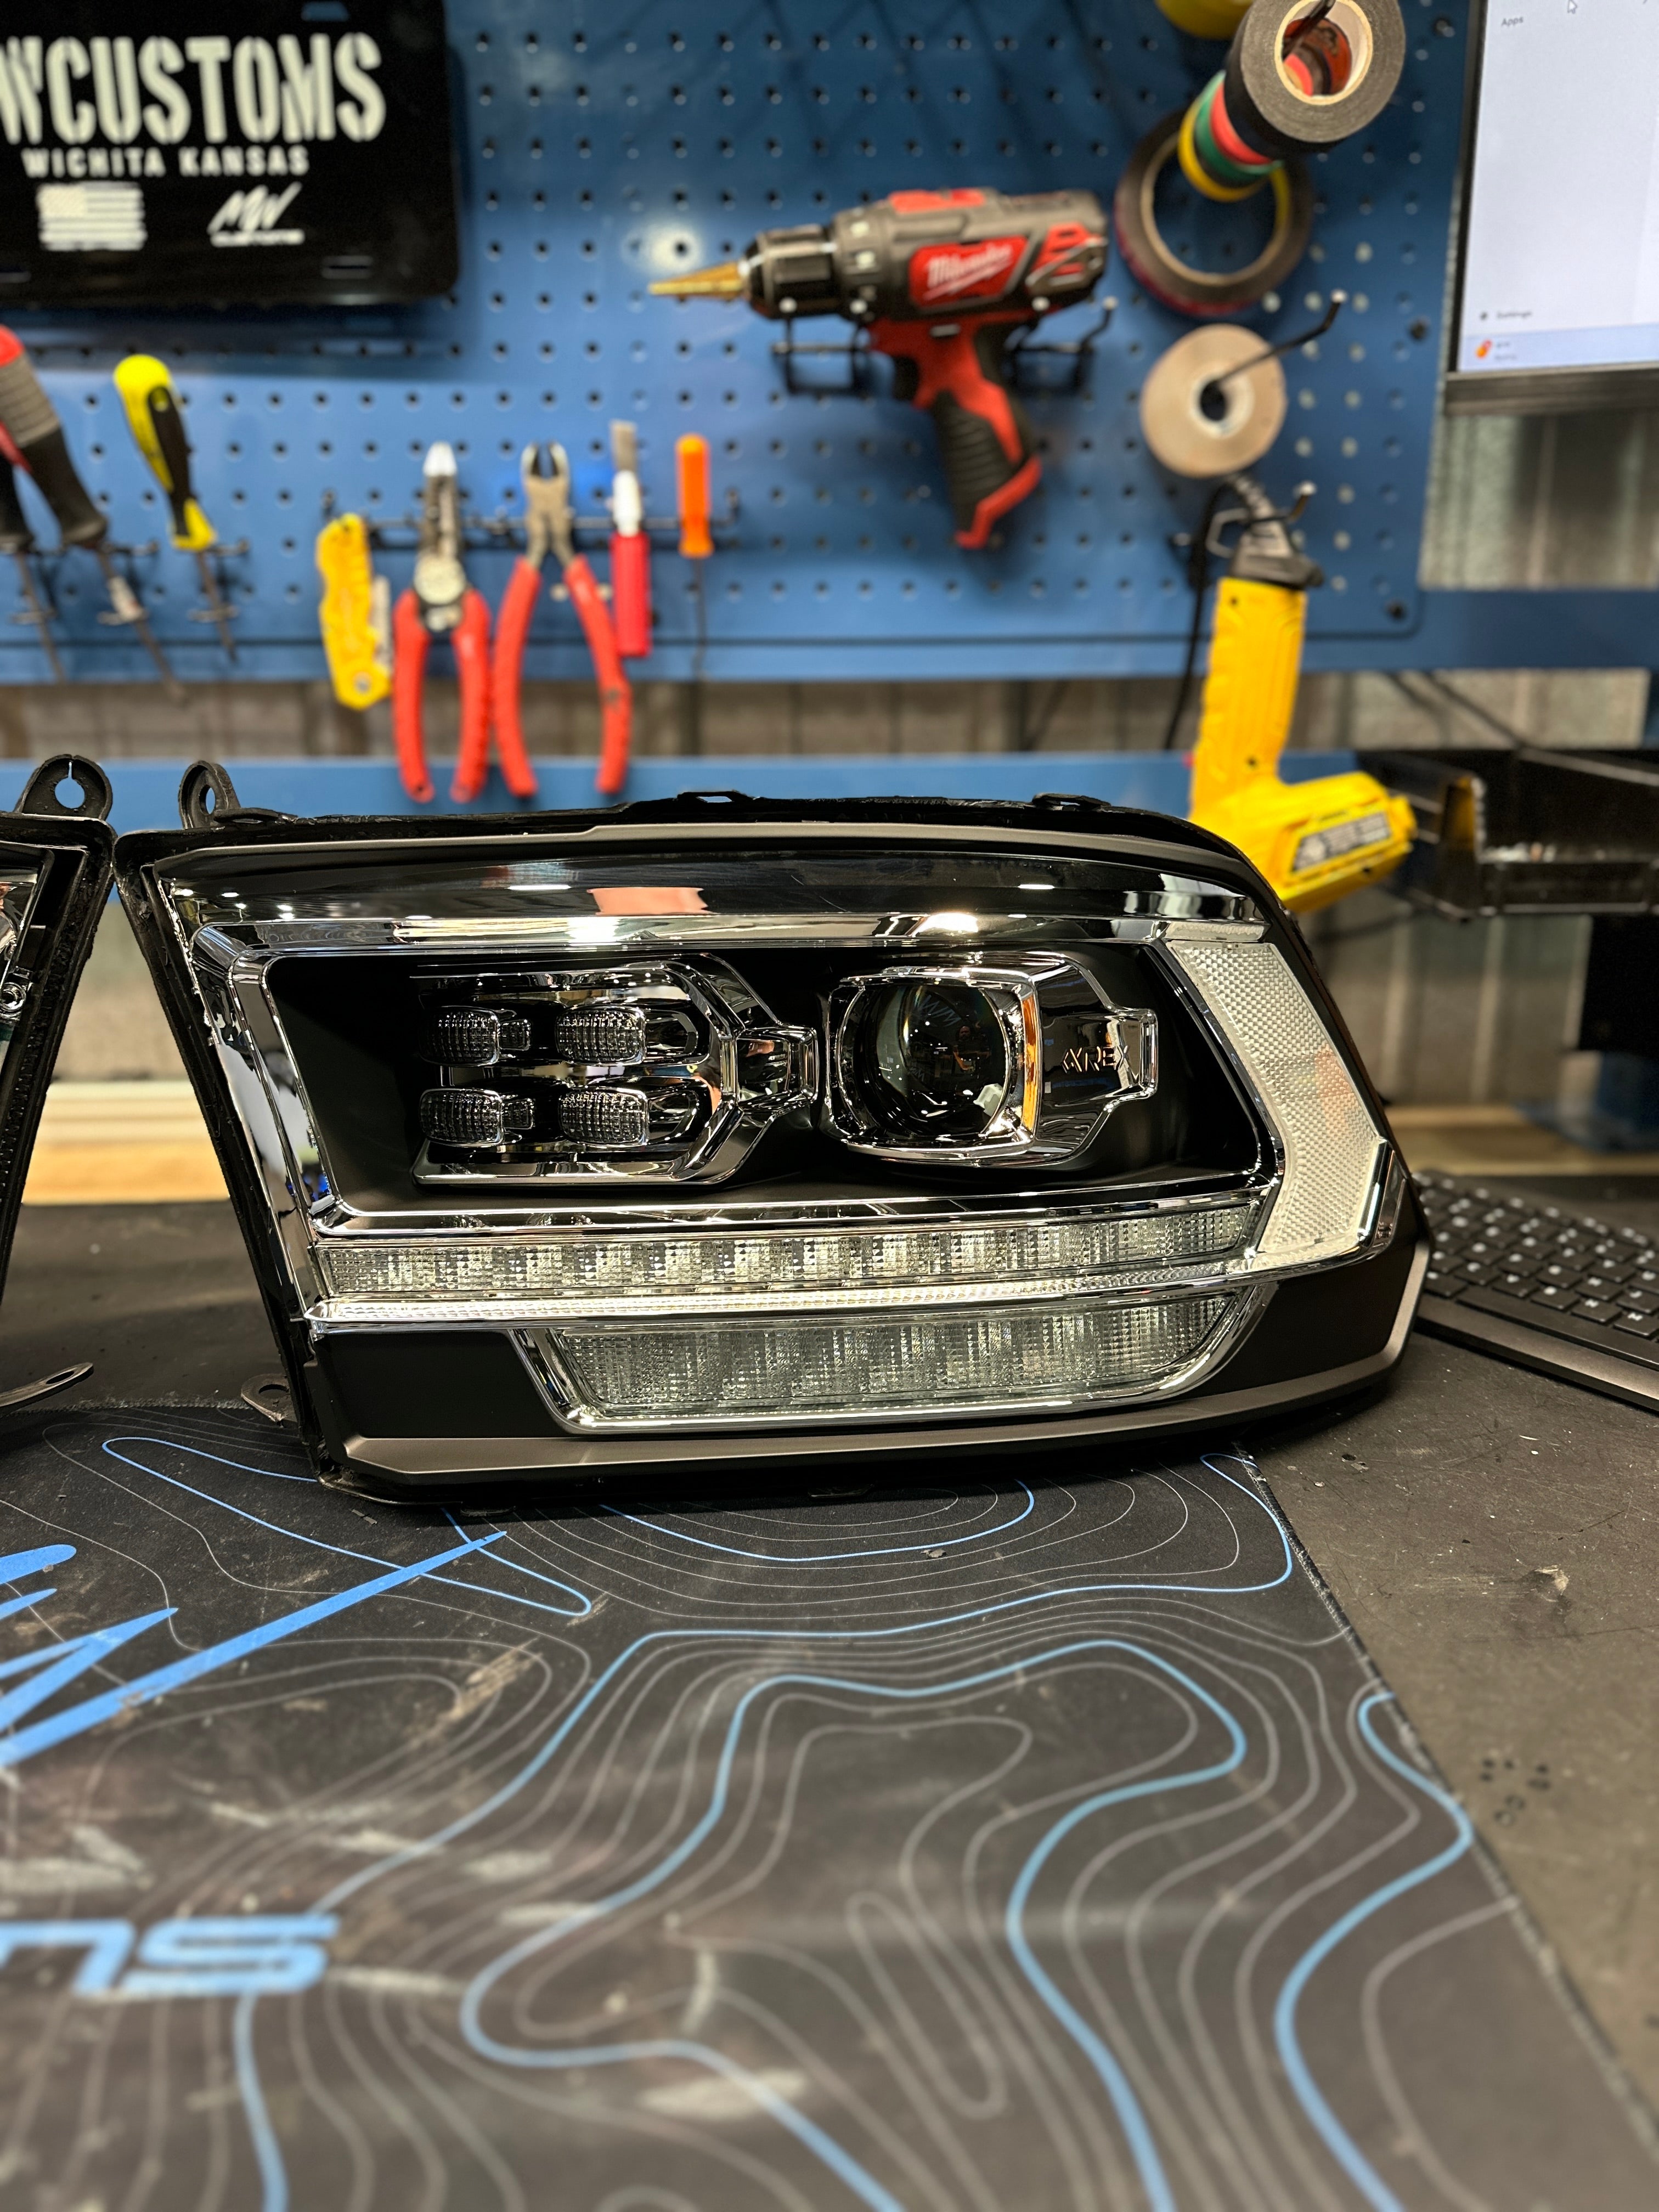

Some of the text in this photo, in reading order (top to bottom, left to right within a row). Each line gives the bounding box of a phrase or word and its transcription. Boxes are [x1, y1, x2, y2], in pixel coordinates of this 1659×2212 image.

[1500, 16, 1524, 29] Apps
[21, 145, 310, 178] WICHITA KANSAS
